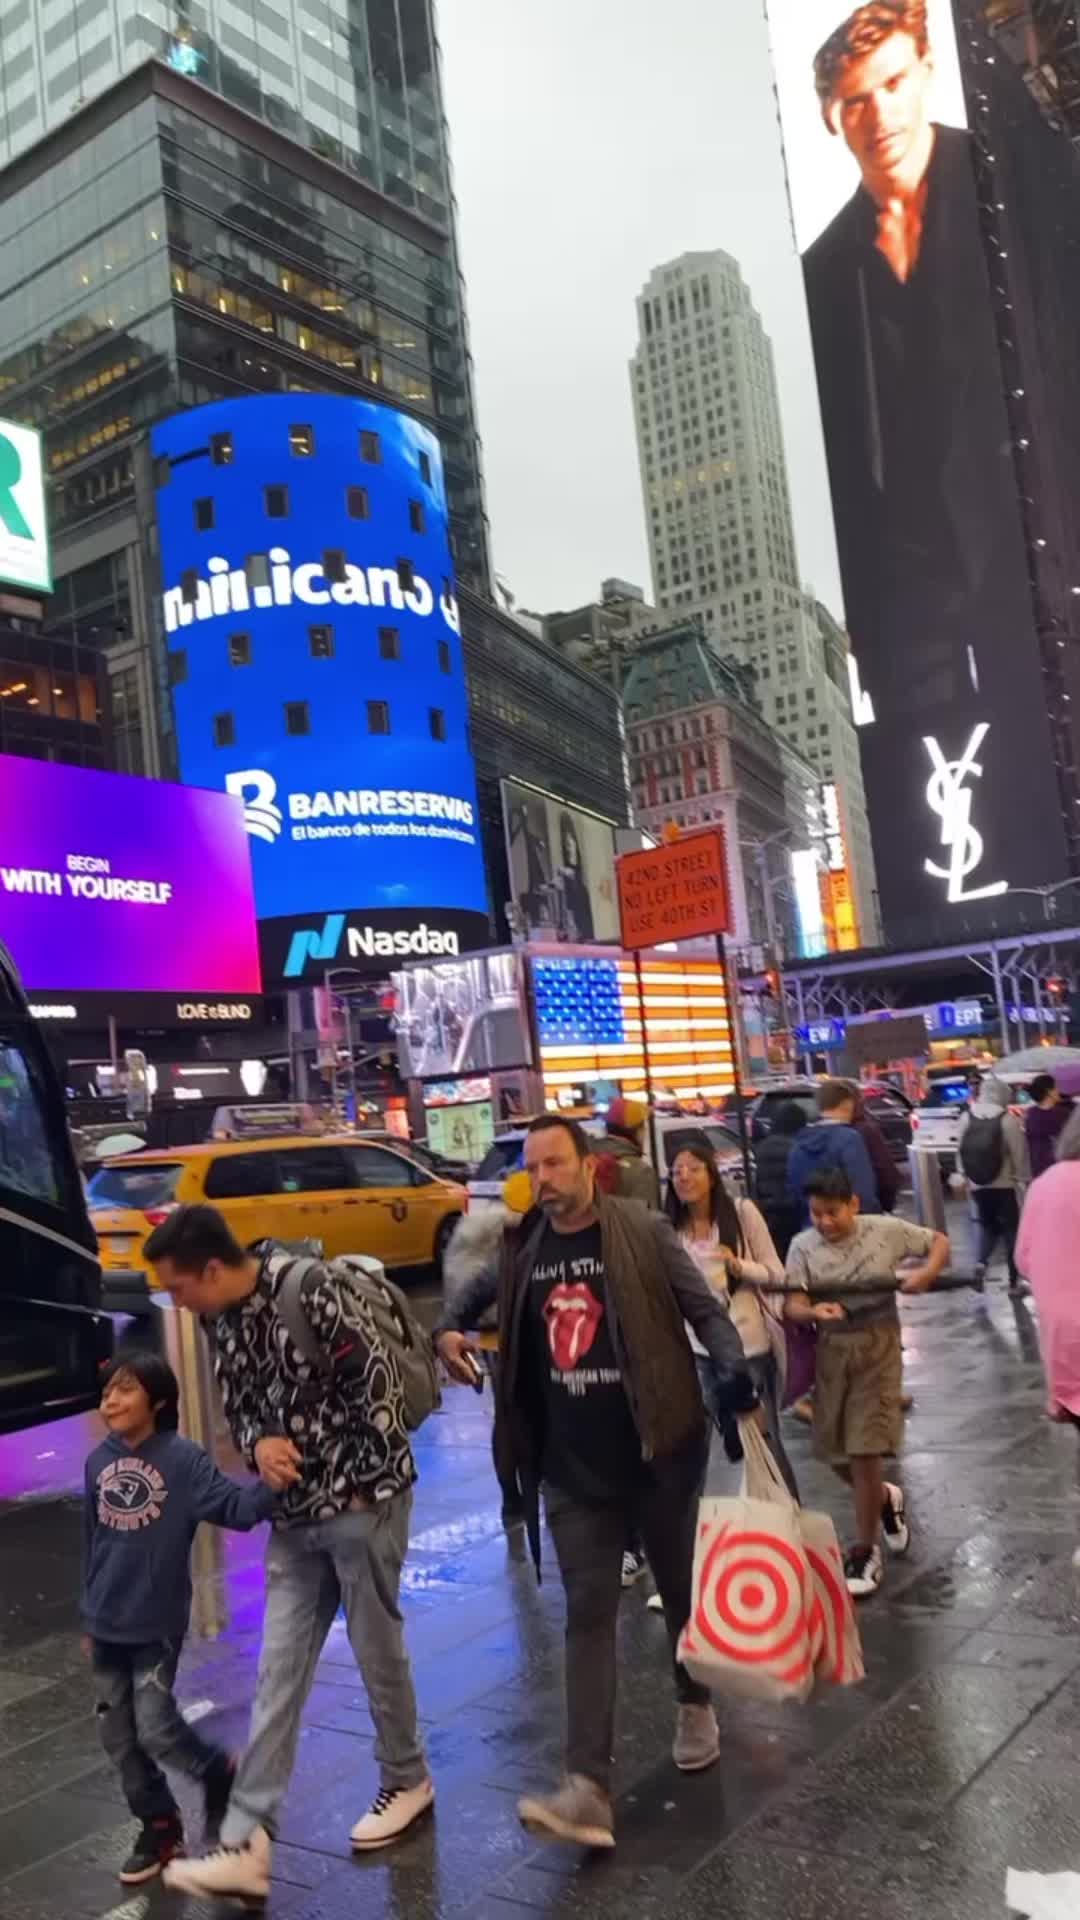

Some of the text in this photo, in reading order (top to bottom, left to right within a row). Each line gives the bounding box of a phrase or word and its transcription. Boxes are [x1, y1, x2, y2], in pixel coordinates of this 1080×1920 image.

[288, 790, 474, 825] BANRESERVAS
[291, 827, 306, 841] El
[307, 825, 351, 840] banco
[353, 821, 371, 836] de
[67, 854, 110, 873] BEGIN
[626, 850, 712, 885] 42ND STREET
[0, 868, 172, 905] WITH YOURSELF
[625, 874, 718, 911] NO LEFT TURN
[630, 898, 715, 932] USE 40TH ST
[347, 923, 459, 957] Nasdaq
